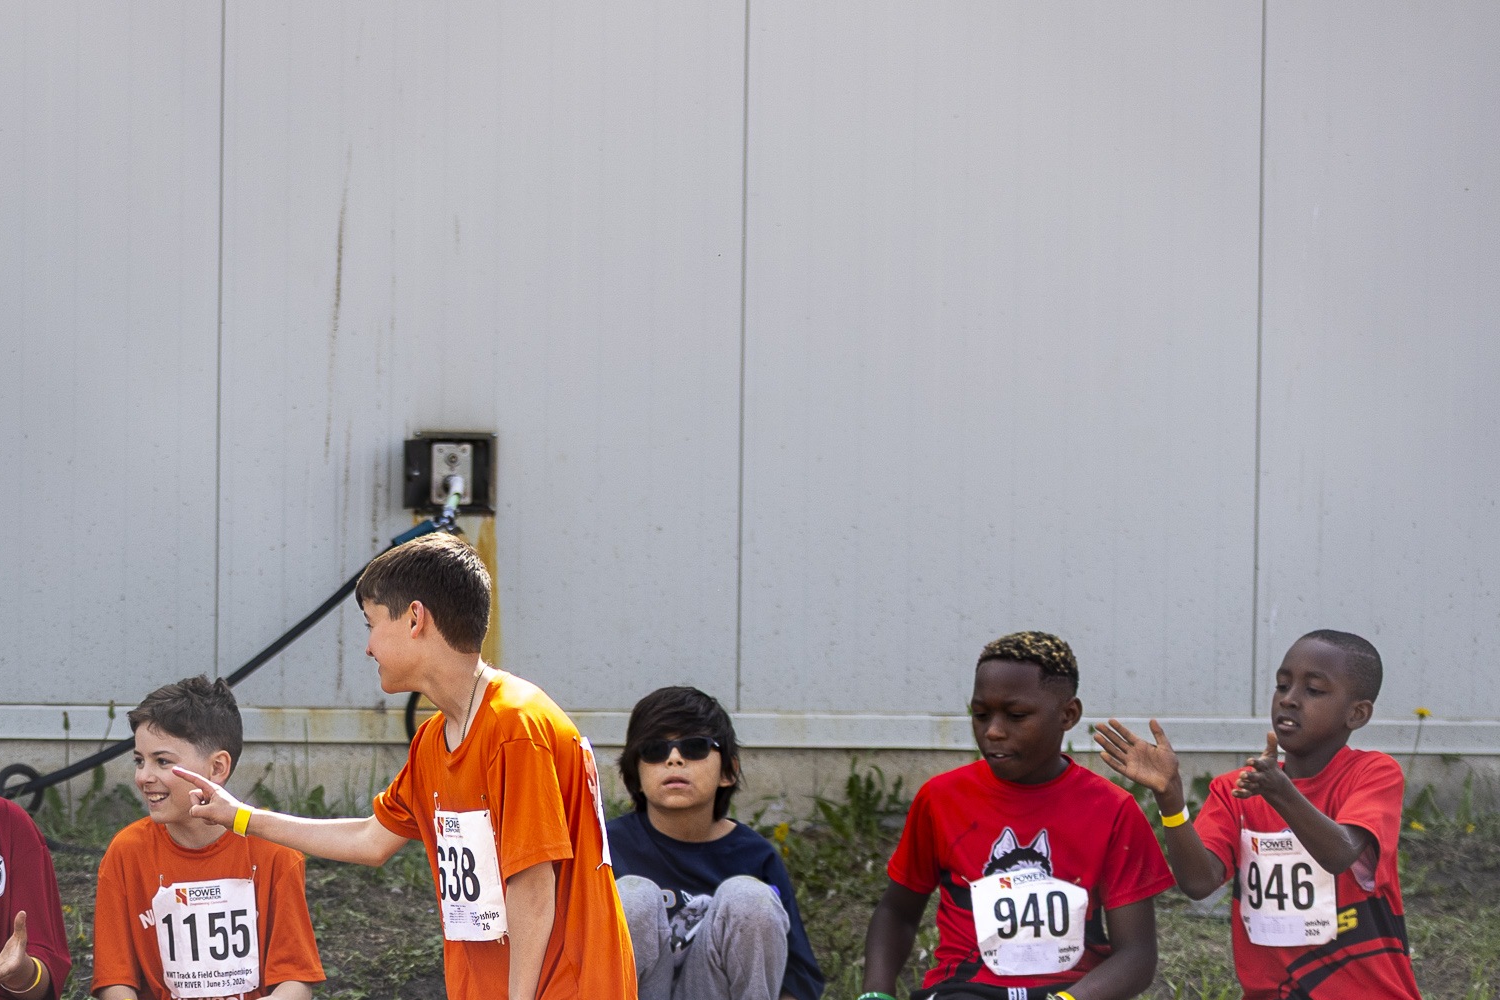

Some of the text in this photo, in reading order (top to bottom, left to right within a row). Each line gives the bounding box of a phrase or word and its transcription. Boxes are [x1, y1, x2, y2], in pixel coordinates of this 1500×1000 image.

[1260, 840, 1293, 849] POWER
[438, 846, 480, 902] 638
[1013, 871, 1046, 884] POWER
[1248, 861, 1315, 911] 946
[188, 888, 221, 898] POWER
[994, 890, 1070, 939] 940
[482, 922, 490, 931] 26
[162, 909, 251, 962] 1155
[166, 971, 177, 979] NWT
[177, 971, 190, 979] Track
[198, 969, 212, 978] Field
[214, 968, 253, 978] Championships
[174, 981, 184, 989] HAY
[207, 980, 221, 988] June
[233, 978, 246, 986] 2026
